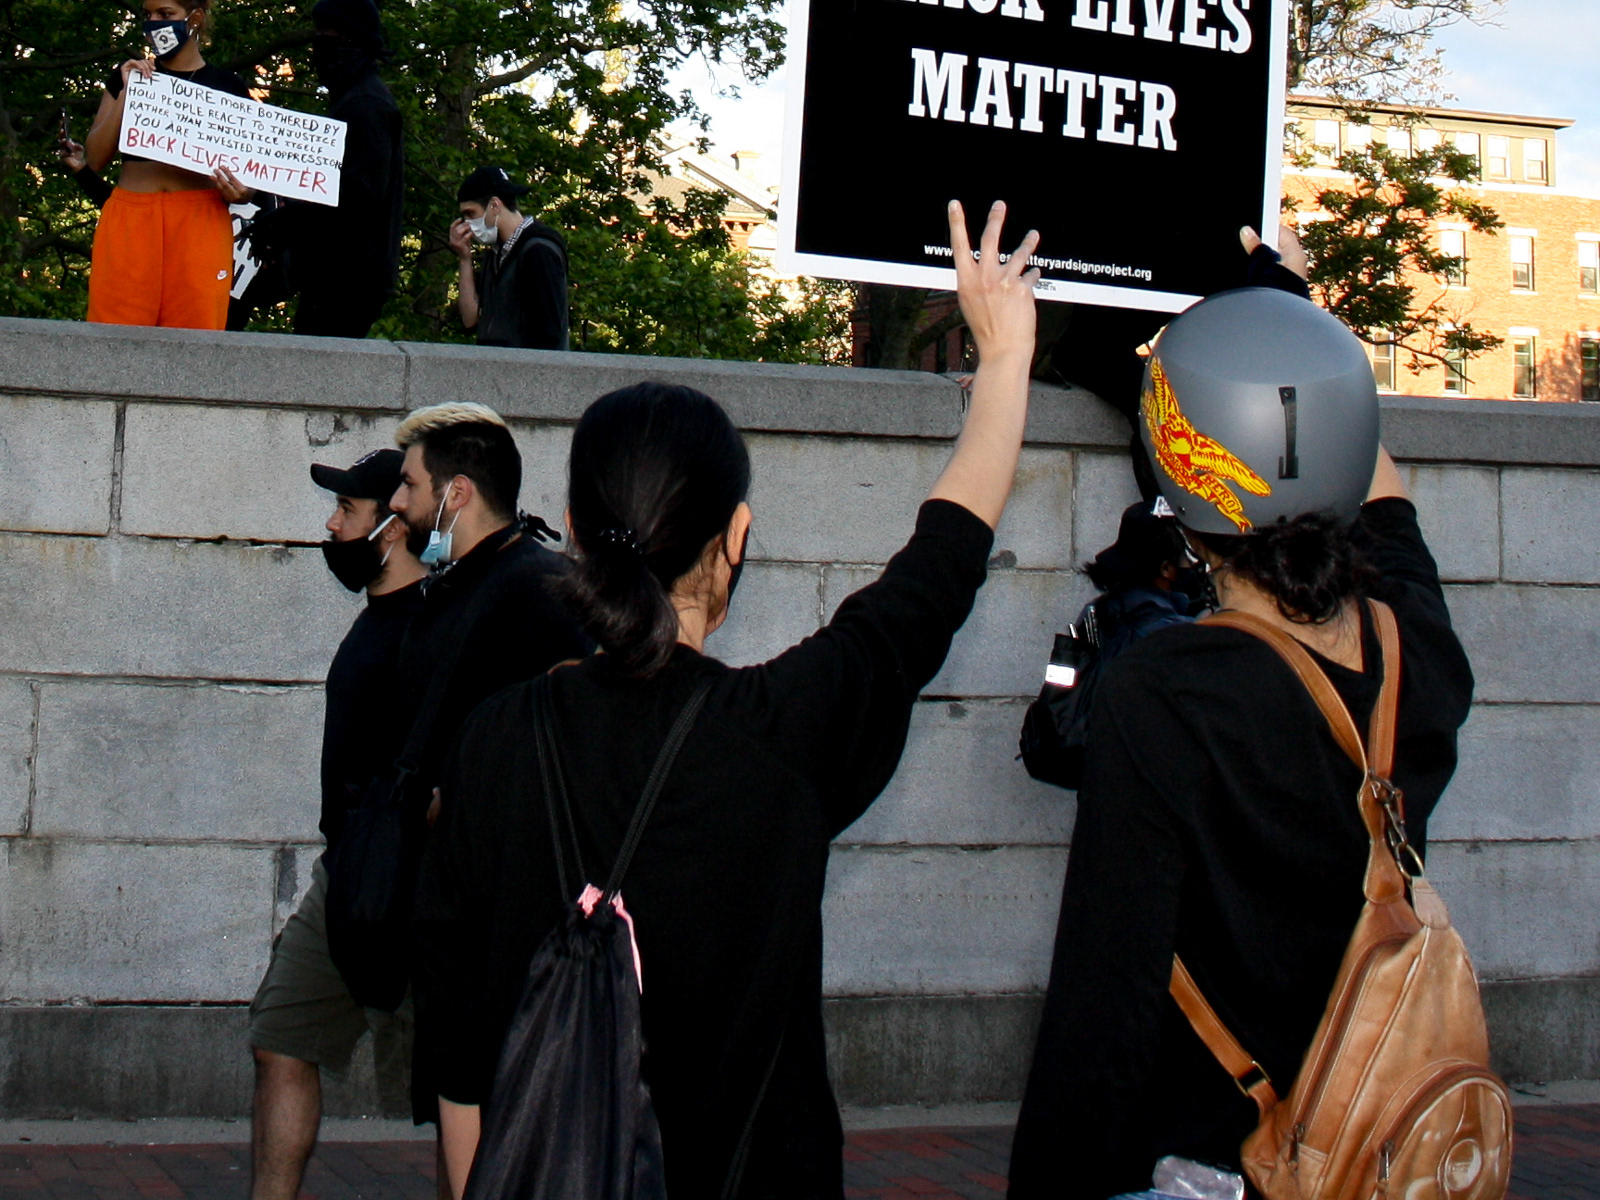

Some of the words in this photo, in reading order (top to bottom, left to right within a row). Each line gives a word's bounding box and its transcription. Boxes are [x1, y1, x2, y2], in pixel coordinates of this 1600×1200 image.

[128, 86, 156, 100] HOW
[161, 94, 204, 117] PEOPLE
[208, 109, 246, 126] REACT
[252, 119, 264, 131] TO
[270, 125, 336, 147] INJUSTICE
[129, 100, 169, 118] RATHER
[175, 112, 202, 128] THAN
[207, 121, 279, 146] INJUSTICE
[133, 70, 160, 86] IF
[170, 77, 215, 104] YOU'RE
[258, 107, 319, 131] BOTHERED
[324, 123, 340, 136] BY
[908, 47, 1177, 151] MATTER
[126, 127, 177, 154] BLACK
[181, 141, 239, 173] LIVES
[243, 158, 327, 195] MATTER
[134, 112, 160, 129] YOU
[165, 121, 189, 138] ARE
[197, 131, 253, 153] INVESTED
[257, 146, 271, 157] IN
[274, 150, 342, 171] OPPRESSION
[1204, 477, 1237, 510] HERO
